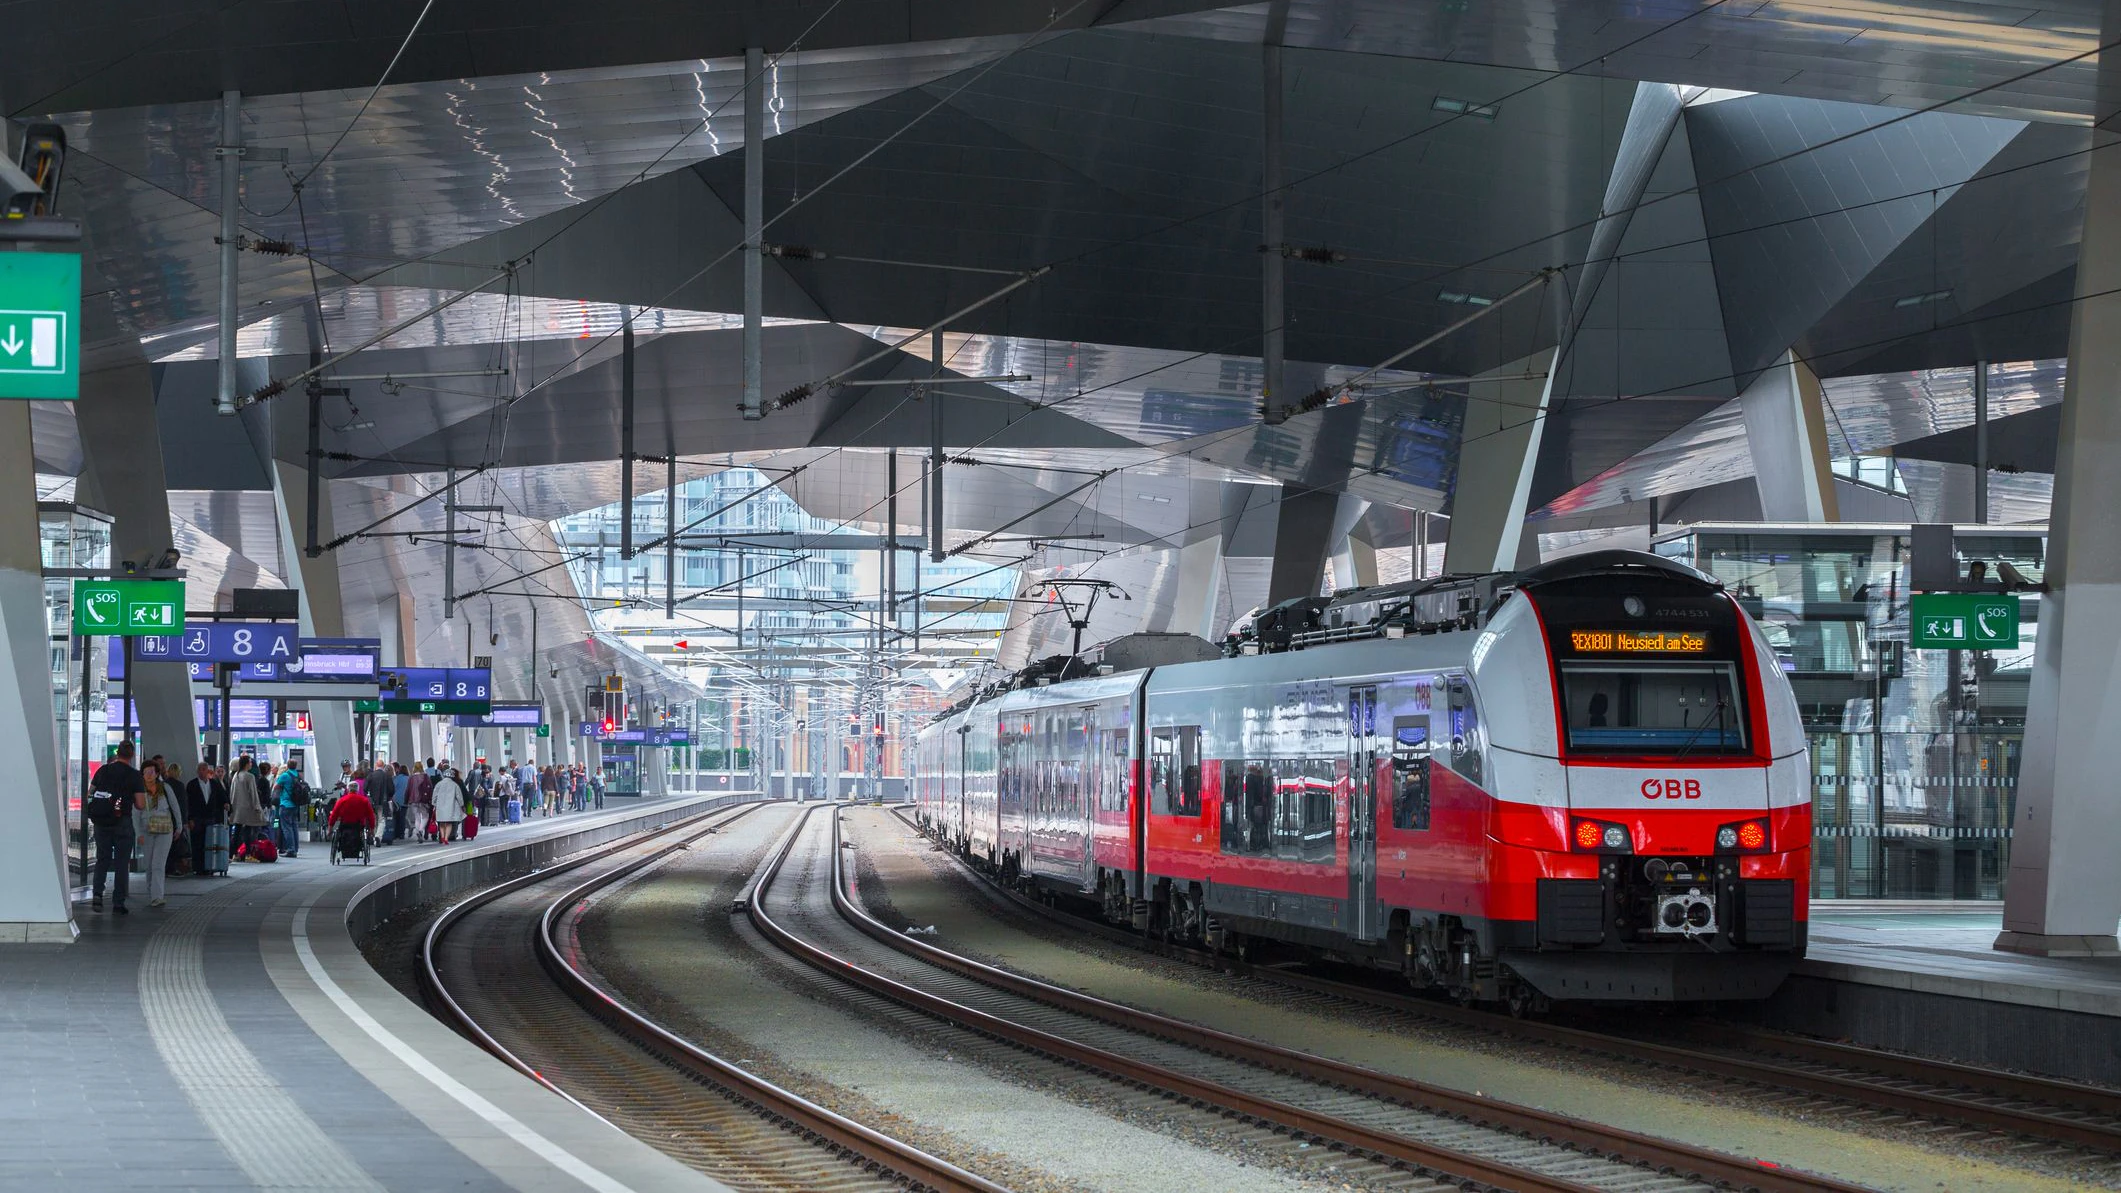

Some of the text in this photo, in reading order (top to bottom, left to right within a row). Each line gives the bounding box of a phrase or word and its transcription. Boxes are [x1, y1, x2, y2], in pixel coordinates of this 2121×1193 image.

[95, 593, 117, 603] SOS
[1655, 608, 1710, 618] 4744 531
[1986, 607, 2007, 618] SOS
[232, 629, 290, 656] 8 A
[1618, 633, 1664, 651] Neusiedl
[1666, 637, 1680, 651] am
[1682, 634, 1703, 651] See
[304, 660, 336, 668] nnsbruck
[477, 656, 489, 667] 70
[190, 662, 200, 675] 8
[456, 682, 486, 697] 8 B
[584, 724, 592, 735] 8
[654, 735, 660, 744] 8
[1640, 778, 1702, 800] ÖBB
